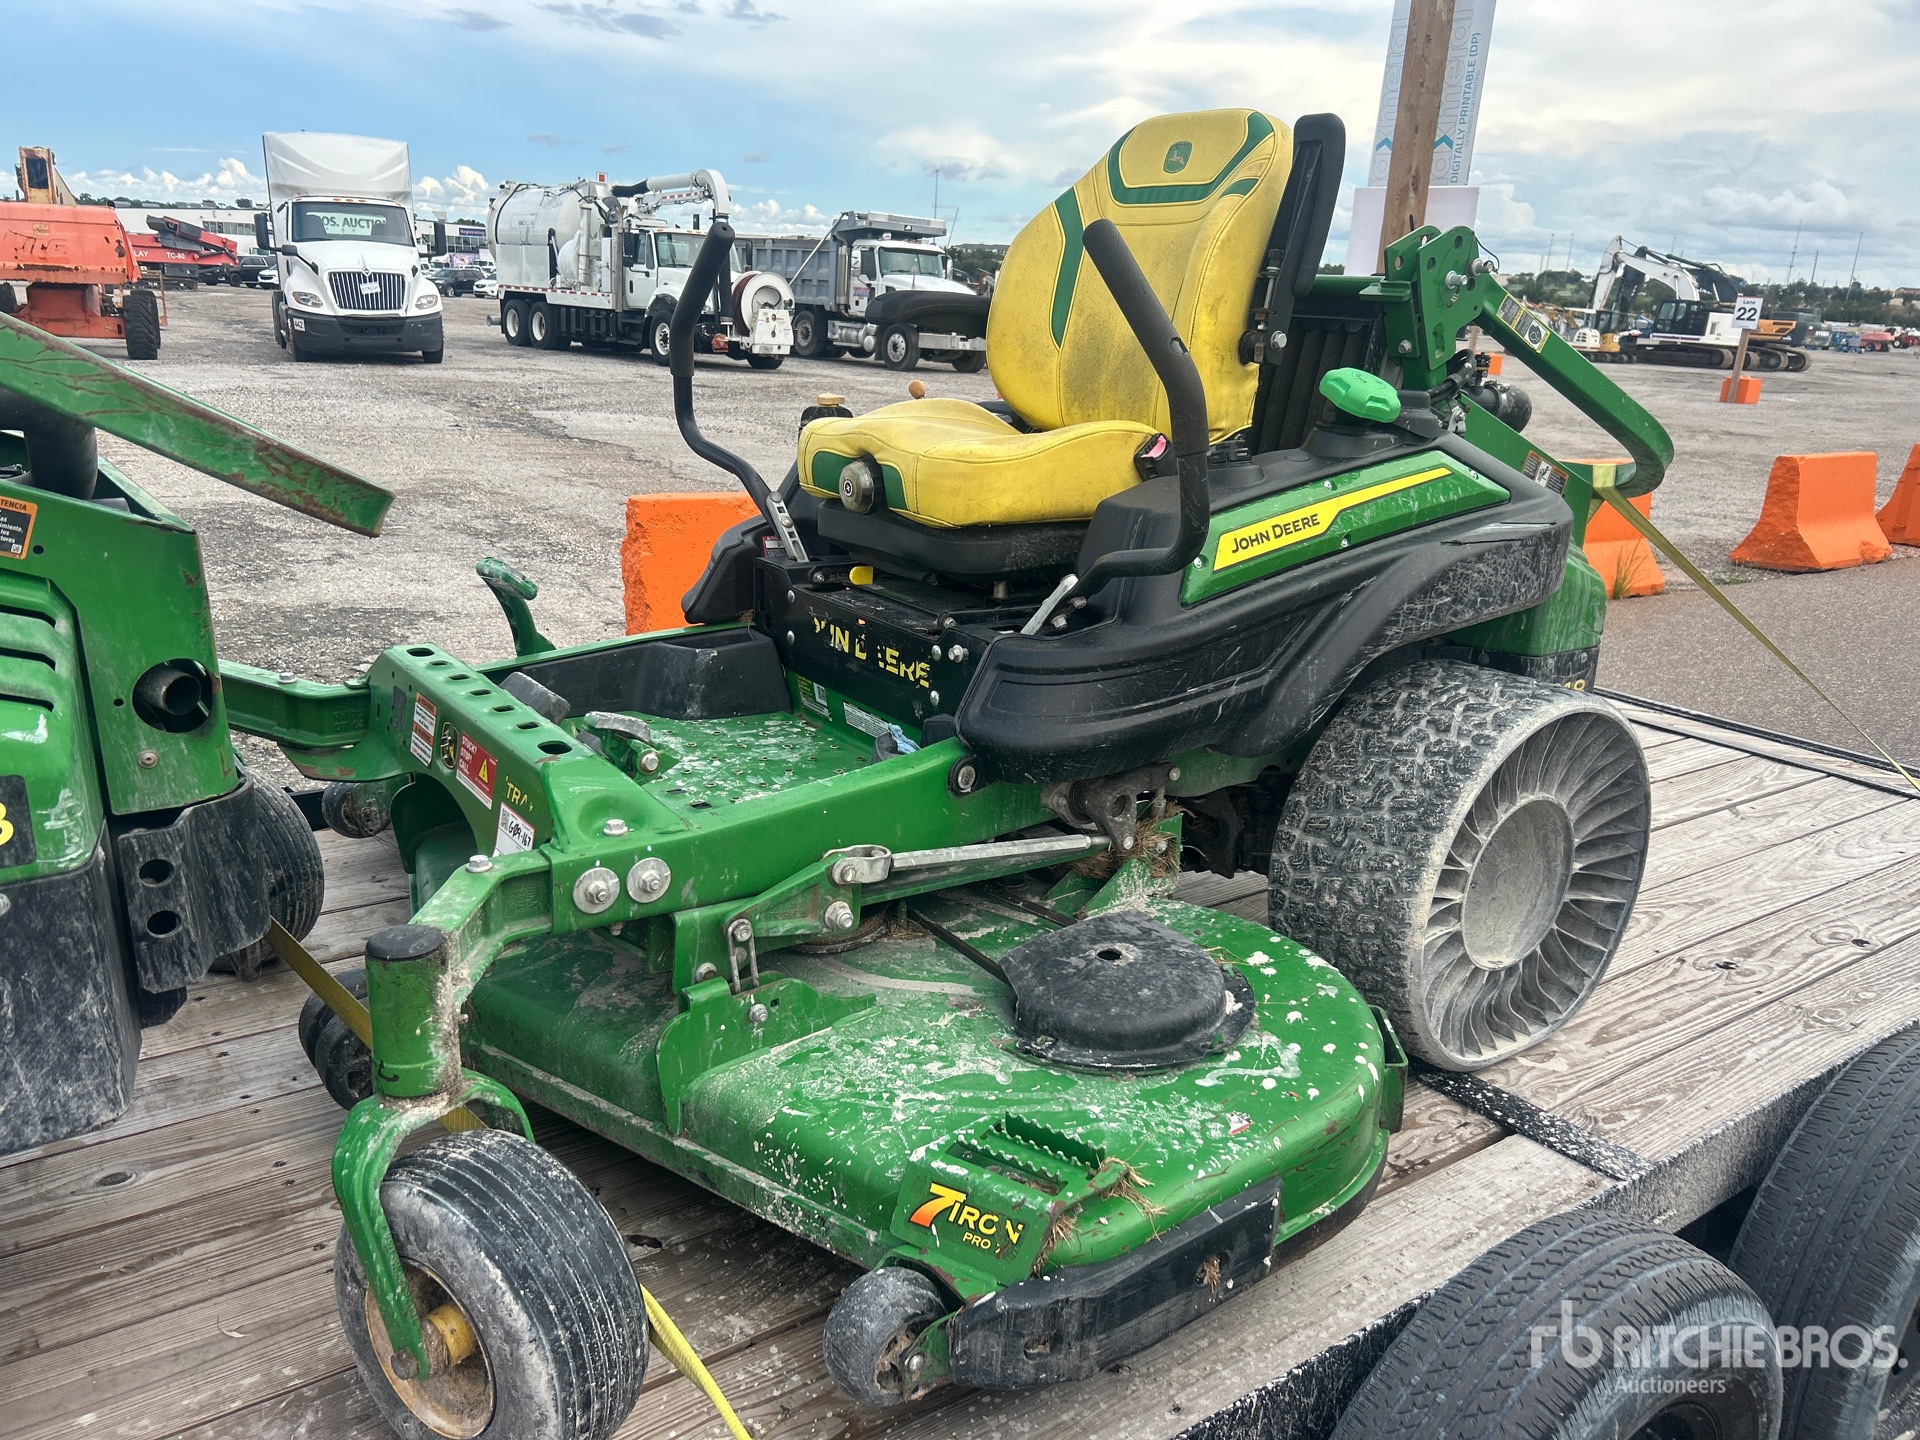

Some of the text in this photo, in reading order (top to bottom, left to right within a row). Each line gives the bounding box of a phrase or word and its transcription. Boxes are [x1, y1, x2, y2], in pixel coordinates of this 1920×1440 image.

[1450, 32, 1481, 184] DIGITALLY PRINTABLE (DP)
[1735, 306, 1758, 322] 22
[1231, 513, 1320, 554] JOHN DEERE
[962, 1231, 992, 1250] PRO
